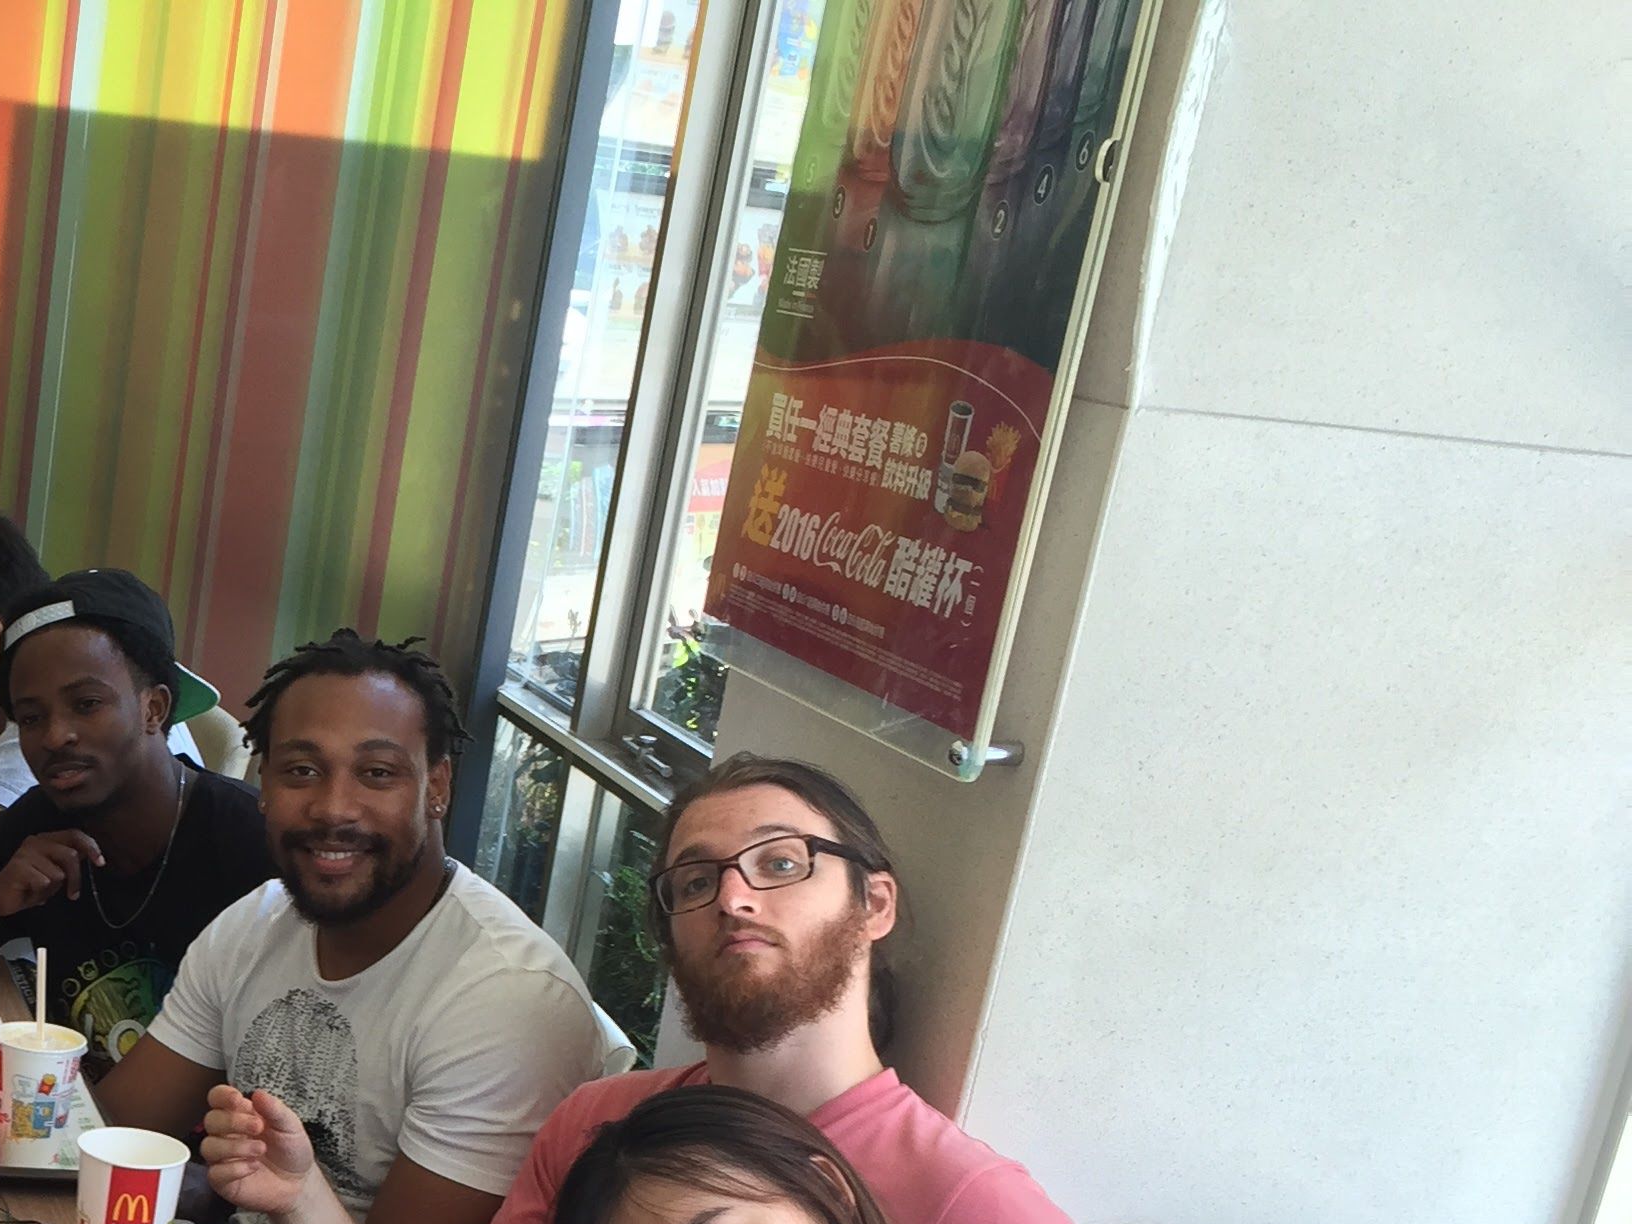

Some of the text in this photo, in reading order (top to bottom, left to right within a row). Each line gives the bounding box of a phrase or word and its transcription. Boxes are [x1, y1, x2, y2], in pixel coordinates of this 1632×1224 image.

[1036, 177, 1047, 199] 4
[834, 193, 843, 213] 3
[994, 208, 1006, 233] 2
[769, 503, 821, 561] 2016
